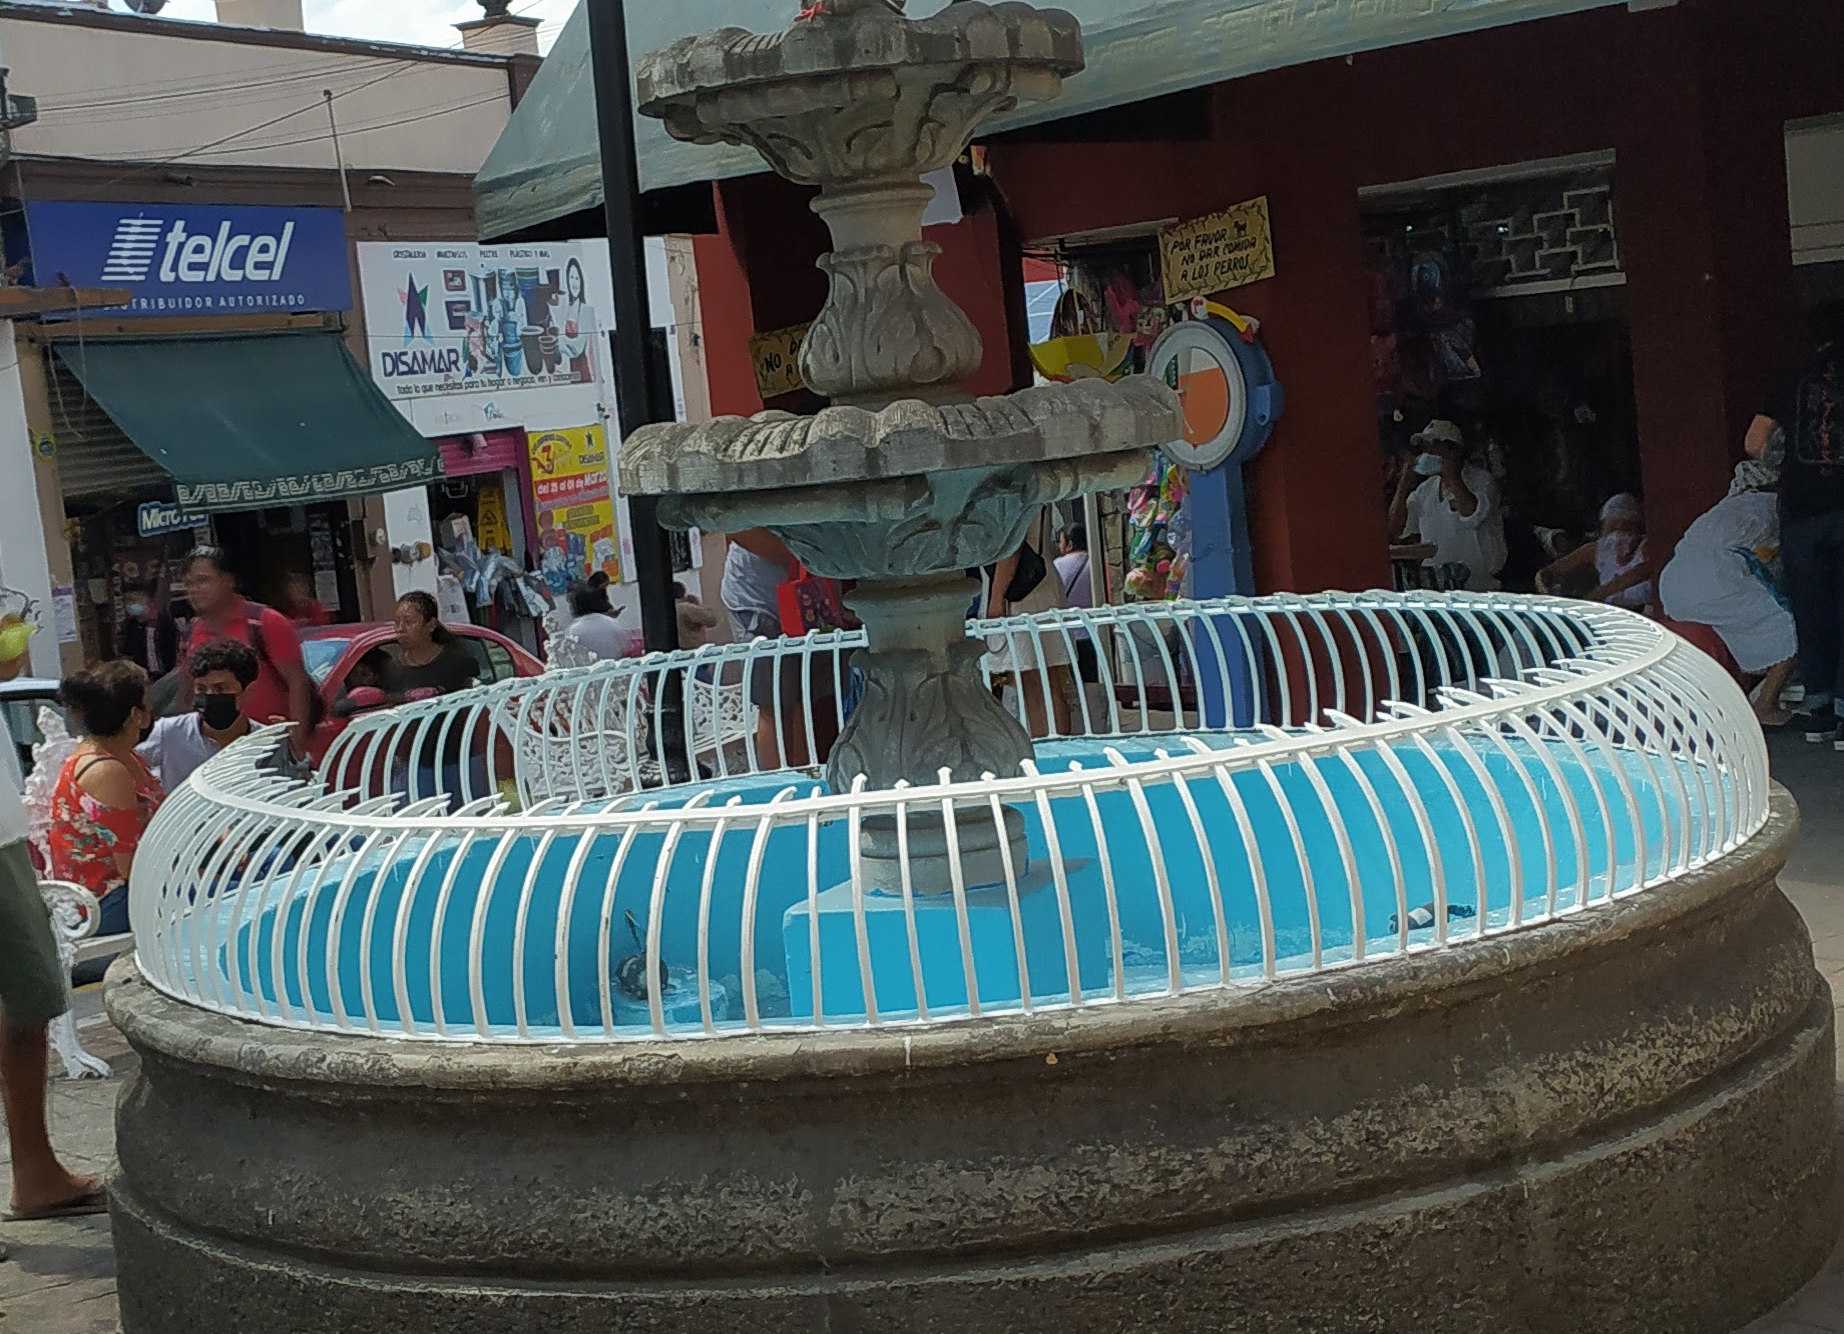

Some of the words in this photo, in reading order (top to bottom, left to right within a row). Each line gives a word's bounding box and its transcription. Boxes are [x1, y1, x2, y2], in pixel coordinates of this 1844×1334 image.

[159, 220, 296, 283] telcel
[1171, 238, 1191, 255] POR
[1195, 228, 1228, 249] FAVOR
[1181, 254, 1195, 267] NO
[1199, 246, 1220, 262] DAR
[1223, 236, 1257, 255] COMIDA
[1180, 269, 1188, 282] A
[1192, 263, 1209, 281] LOS
[1214, 253, 1251, 276] PERROS
[103, 295, 213, 311] TRIBUIDOR
[219, 294, 305, 308] AUTORIZADO
[381, 347, 463, 378] DISAMAR
[764, 352, 782, 373] NO
[396, 385, 412, 395] Todo
[414, 384, 420, 393] lo
[422, 384, 433, 394] que
[435, 381, 463, 391] necesitas
[464, 380, 479, 390] para
